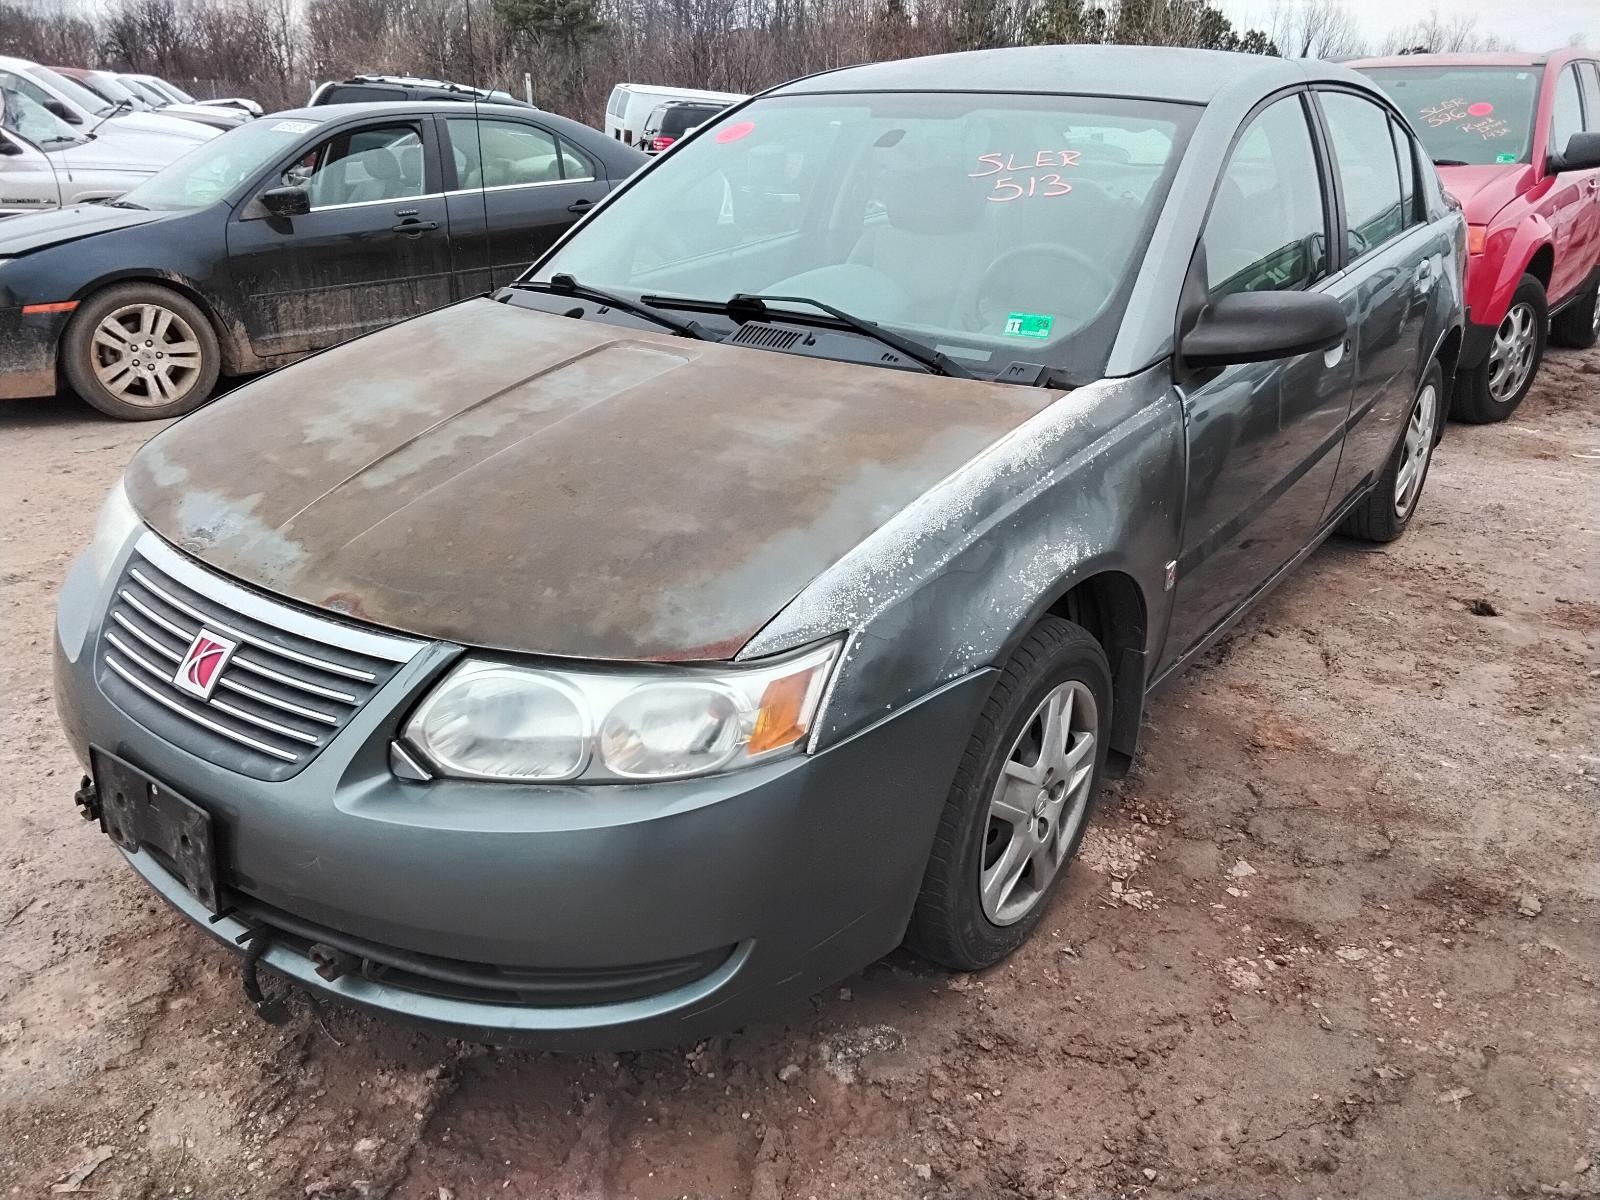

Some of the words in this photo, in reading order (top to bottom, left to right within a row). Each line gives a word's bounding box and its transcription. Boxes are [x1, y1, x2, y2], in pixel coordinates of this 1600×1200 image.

[1427, 109, 1467, 128] 526
[968, 151, 1081, 177] SLER
[987, 174, 1073, 202] 513
